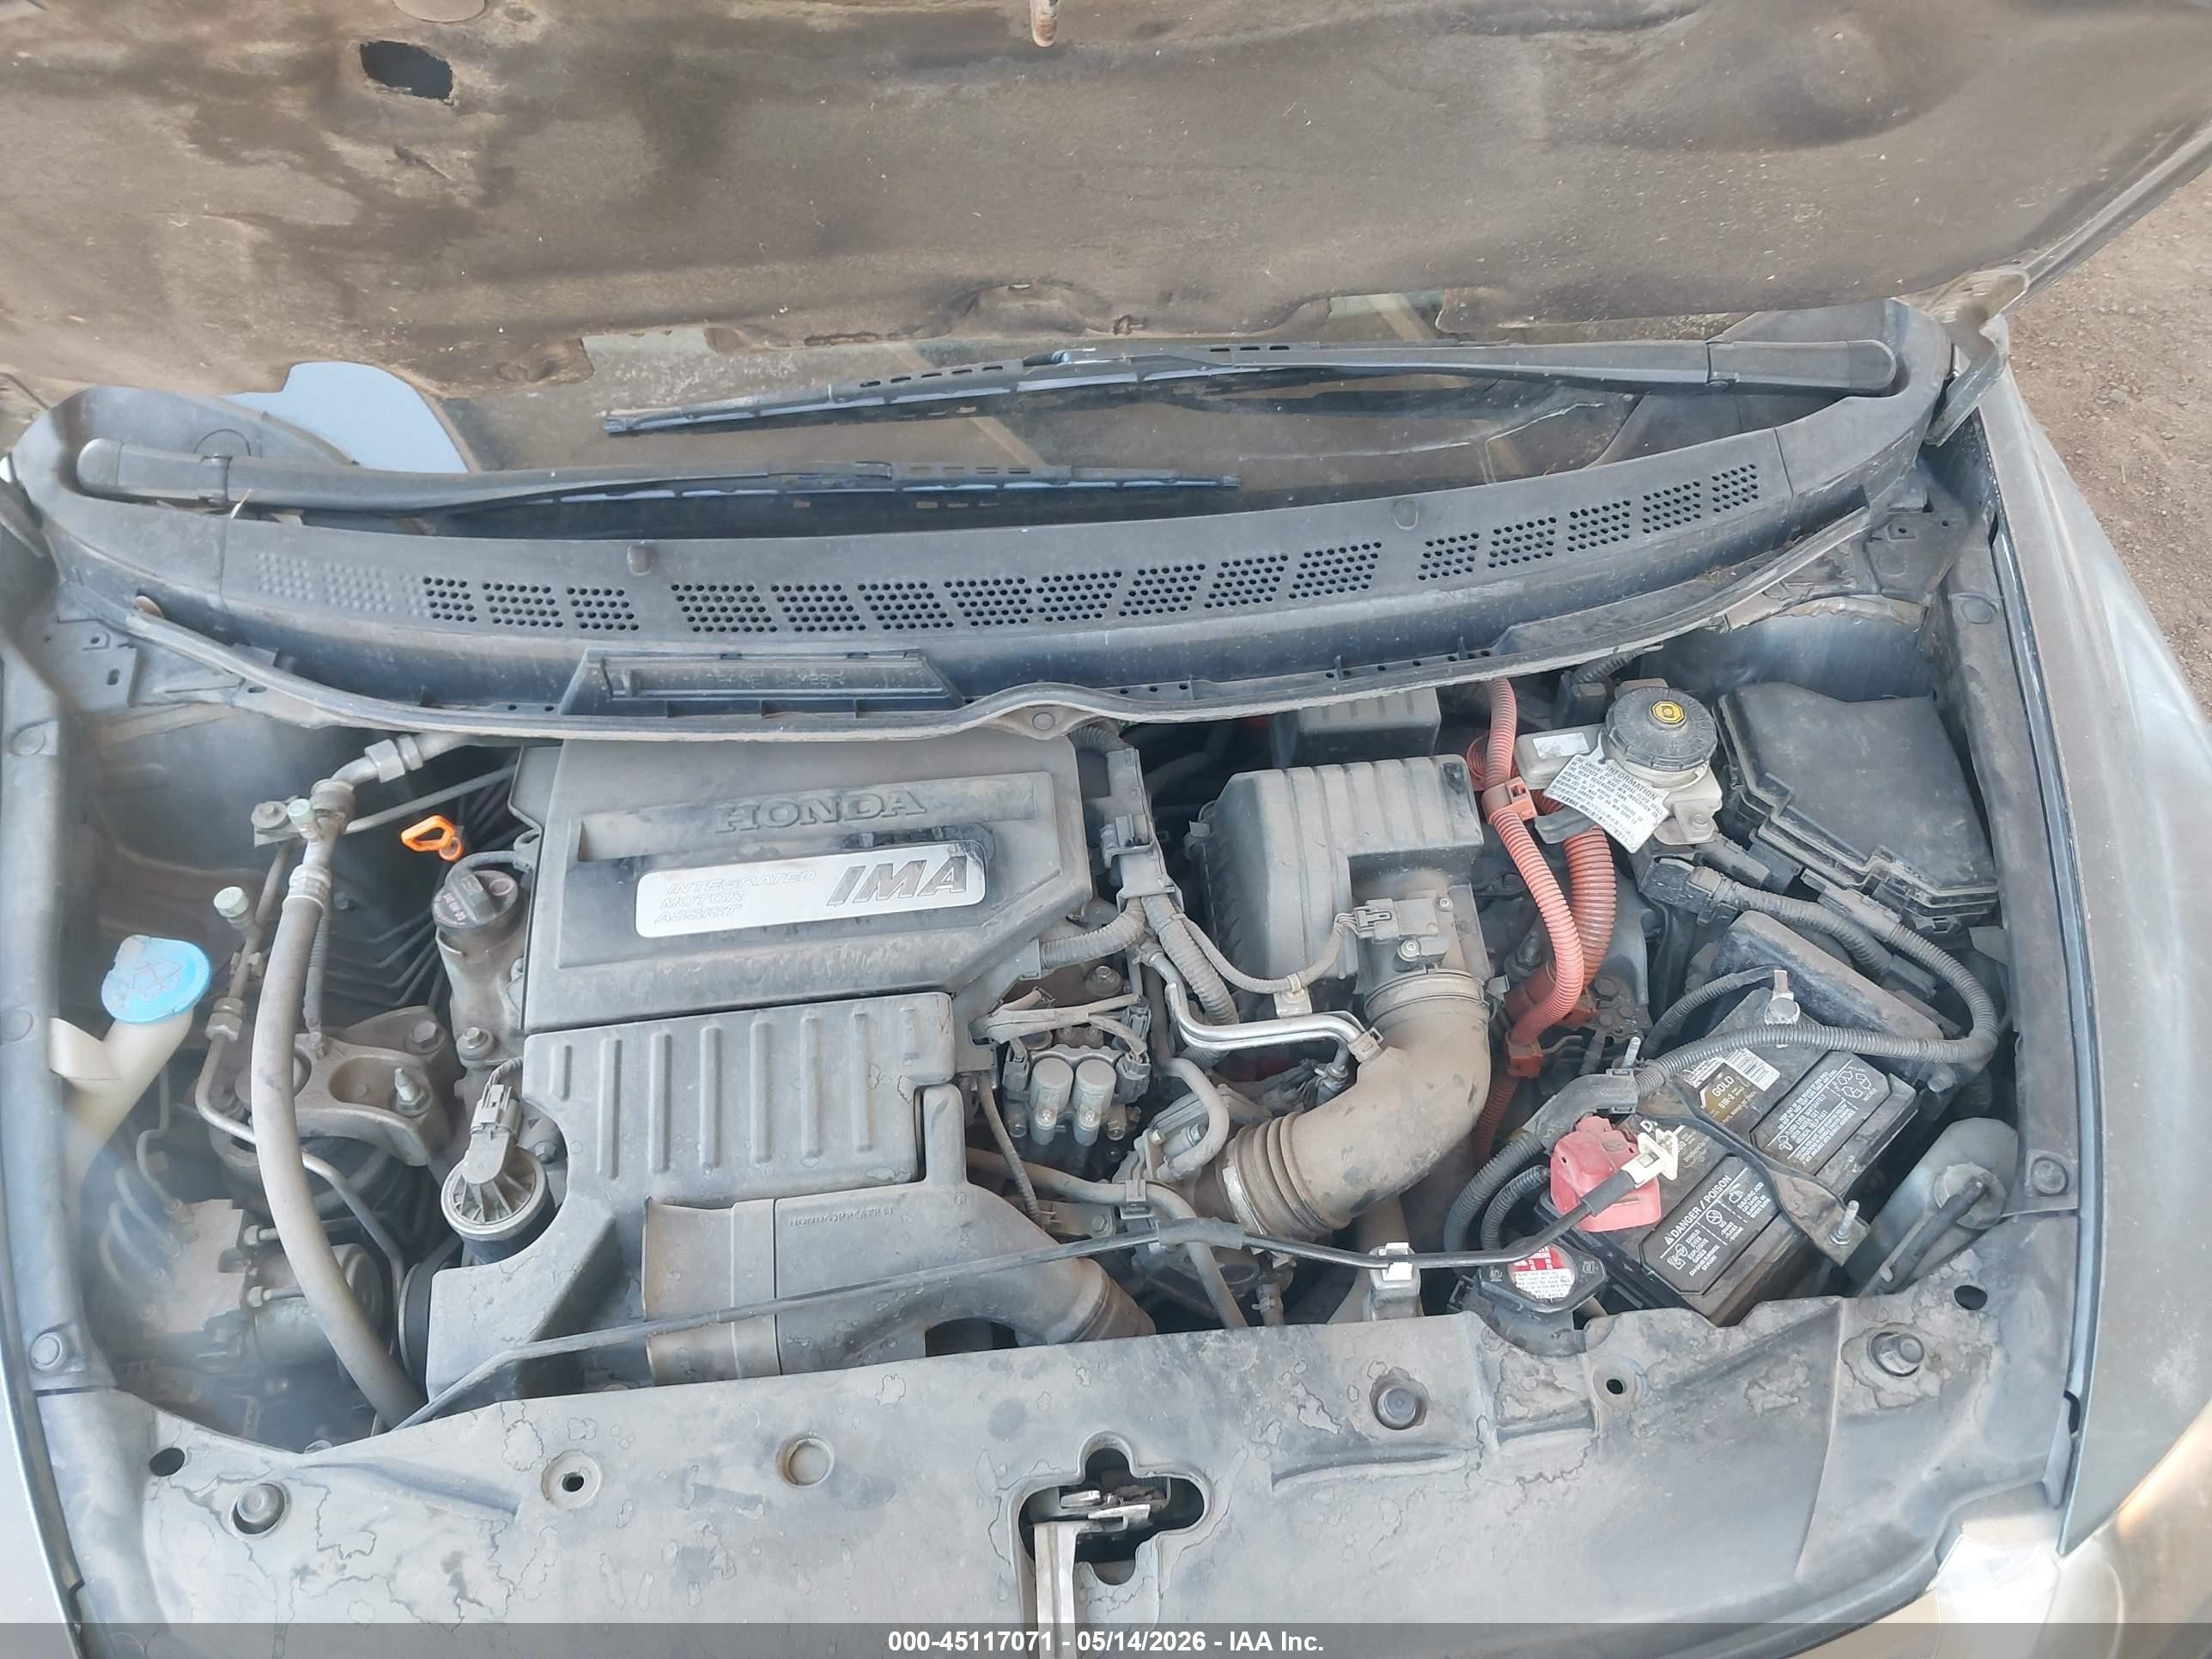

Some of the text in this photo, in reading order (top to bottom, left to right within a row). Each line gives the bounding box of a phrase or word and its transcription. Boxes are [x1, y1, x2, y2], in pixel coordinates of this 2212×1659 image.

[1605, 763, 1658, 801] INFORMATION
[715, 790, 927, 834] HONDA
[667, 871, 816, 894] INTEGRATED
[827, 855, 968, 906] IMA
[660, 890, 745, 908] MOTOR
[653, 904, 741, 922] ASSIST
[1710, 1073, 1735, 1097] GOLD
[1717, 1091, 1735, 1109] 51R-2
[1701, 1172, 1734, 1204] POISON
[1697, 1199, 1707, 1209] /
[1667, 1204, 1704, 1239] DANGER
